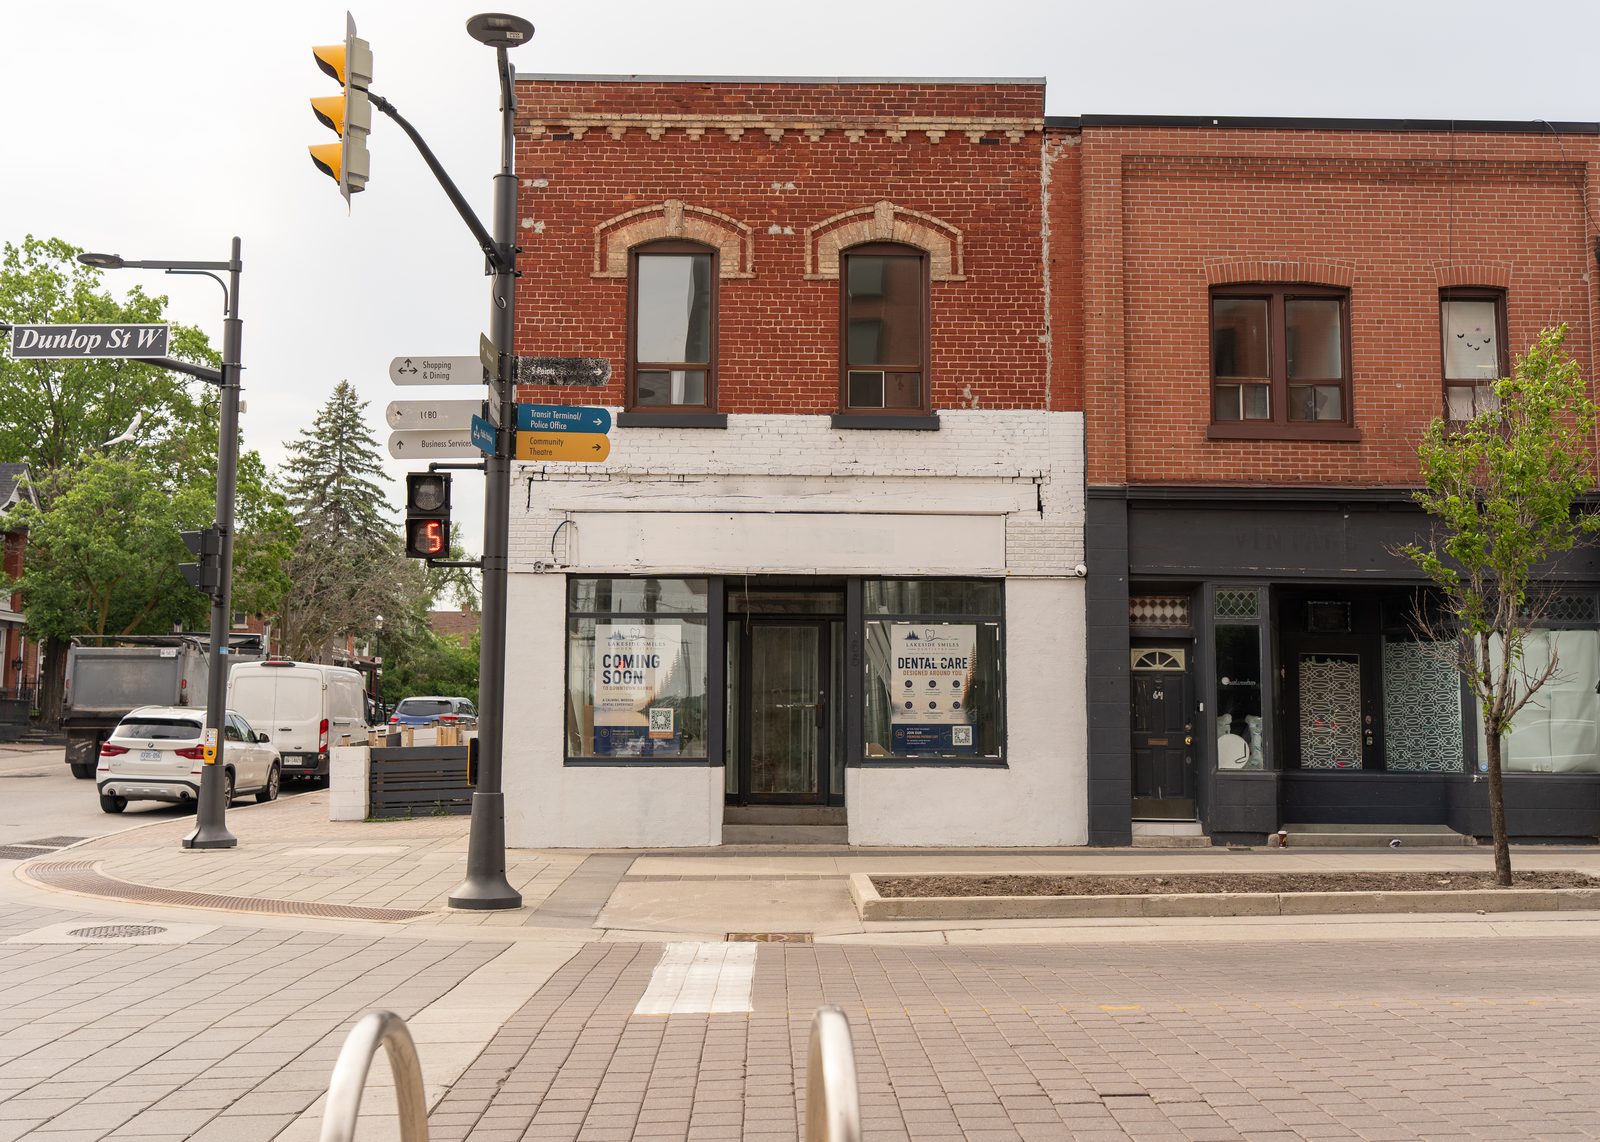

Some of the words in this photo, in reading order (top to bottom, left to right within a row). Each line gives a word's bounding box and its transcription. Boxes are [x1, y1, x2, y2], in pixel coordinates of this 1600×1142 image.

[16, 329, 101, 353] Dunlop
[106, 328, 131, 349] St
[137, 328, 163, 349] W
[422, 361, 452, 370] Shopping
[536, 366, 556, 375] Points
[422, 371, 428, 380] &
[429, 371, 450, 381] Dining
[530, 409, 551, 418] Transit
[553, 411, 582, 421] Terminal/
[530, 420, 548, 429] Police
[549, 421, 567, 430] Office
[421, 440, 447, 448] Business
[448, 440, 472, 448] Services
[529, 437, 564, 447] Community
[529, 448, 553, 456] Theatre
[426, 523, 441, 552] 5
[602, 654, 660, 668] COMING
[897, 657, 937, 669] DENTAL
[940, 657, 968, 669] CARE
[602, 670, 643, 684] SOON
[1152, 690, 1164, 700] 64
